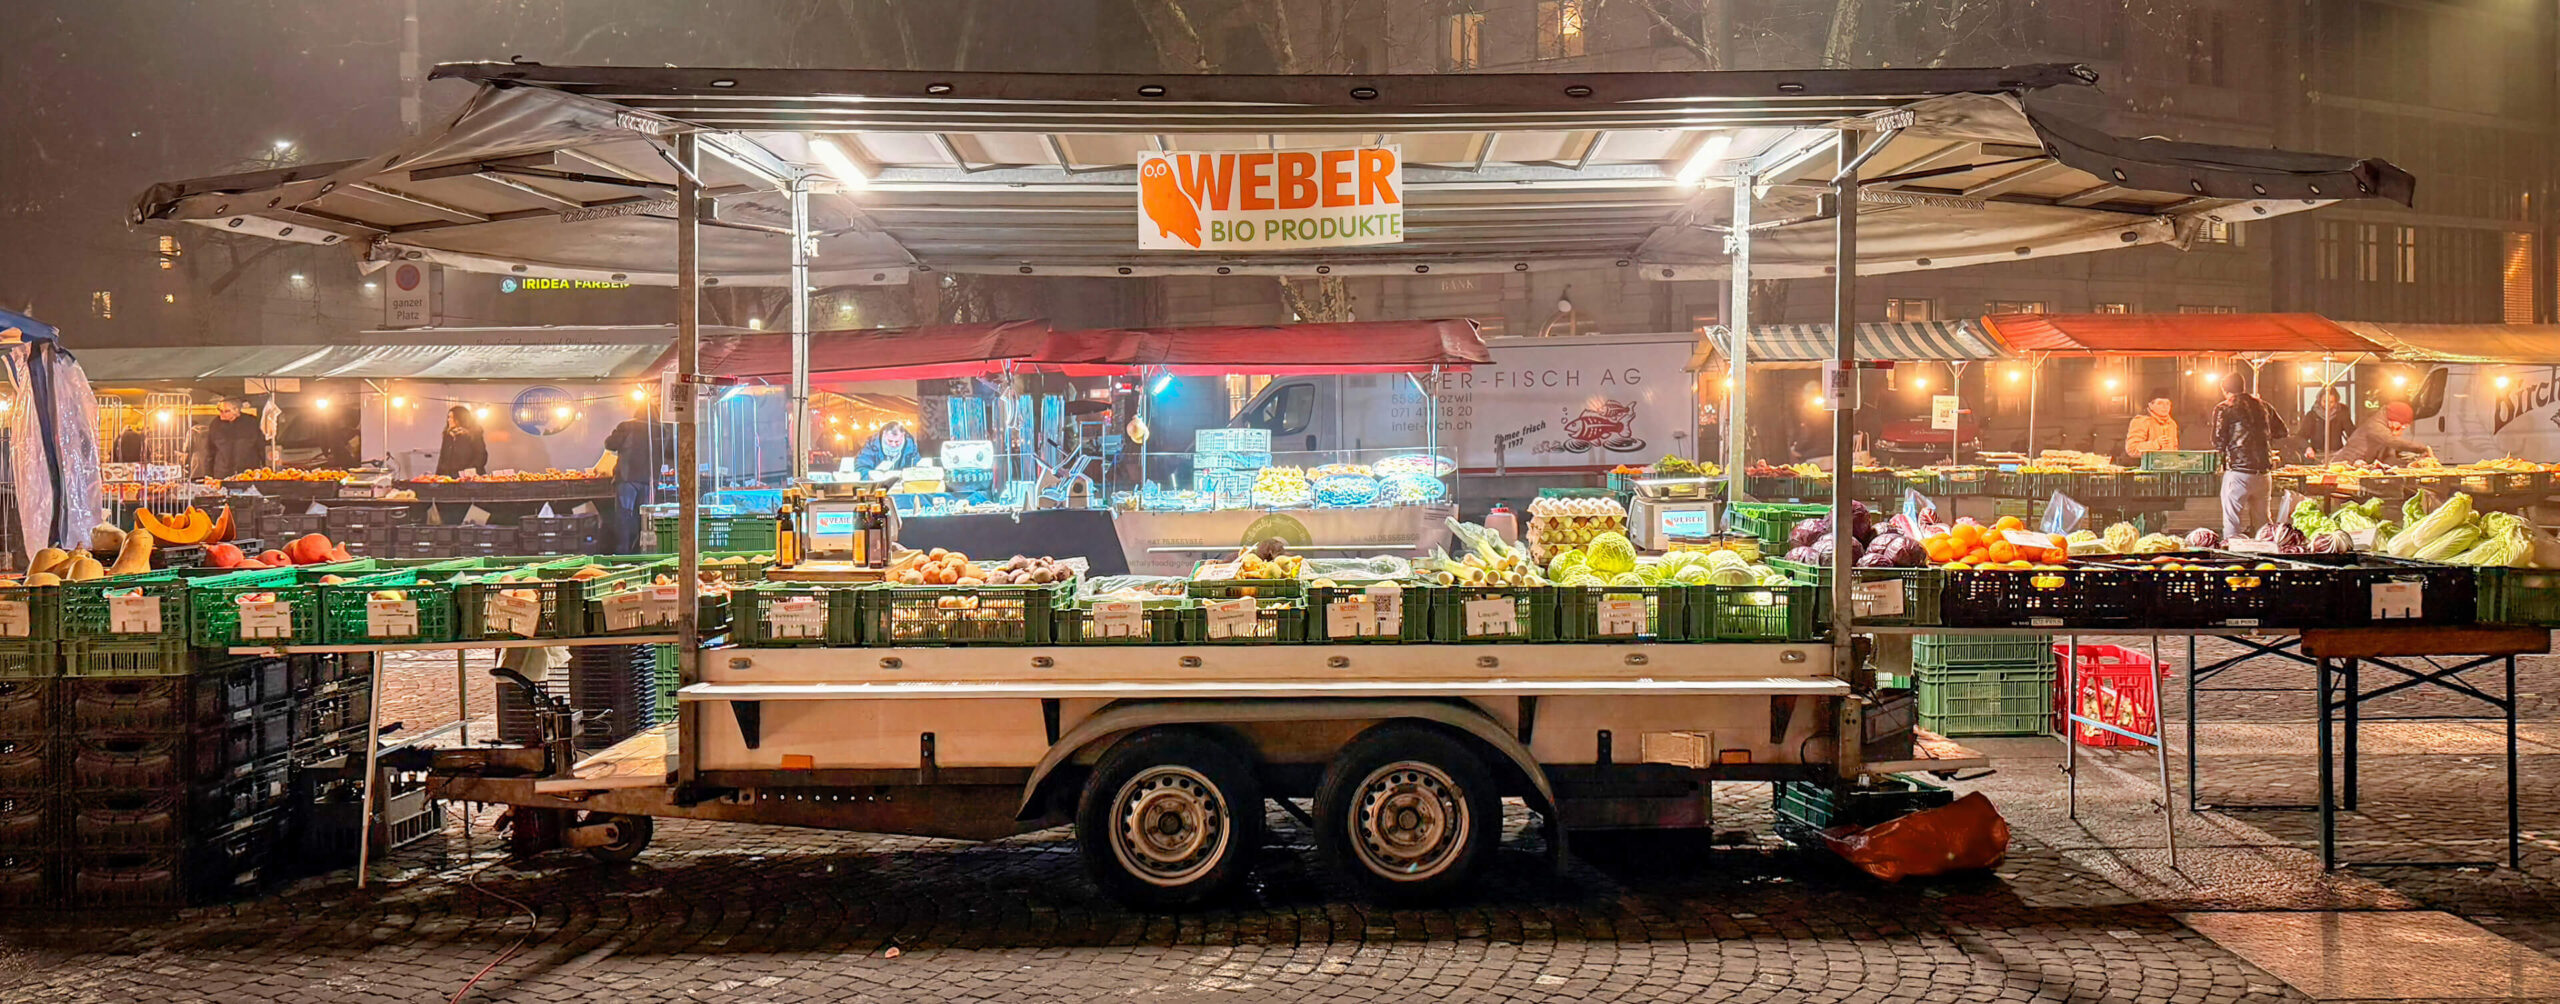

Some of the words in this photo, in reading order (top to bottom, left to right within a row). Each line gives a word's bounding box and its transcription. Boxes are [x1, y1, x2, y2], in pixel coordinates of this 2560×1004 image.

[1176, 148, 1400, 211] WEBER
[1211, 220, 1255, 242] BIO
[1265, 213, 1401, 242] PRODUKTE
[522, 278, 570, 289] IRIDEA
[396, 310, 420, 320] Platz
[1600, 368, 1641, 386] AG
[1428, 392, 1472, 403] ozwil
[1441, 406, 1454, 417] 18
[1458, 405, 1473, 417] 20
[1391, 420, 1472, 432] inter-fch.ch
[1522, 419, 1546, 436] frisch
